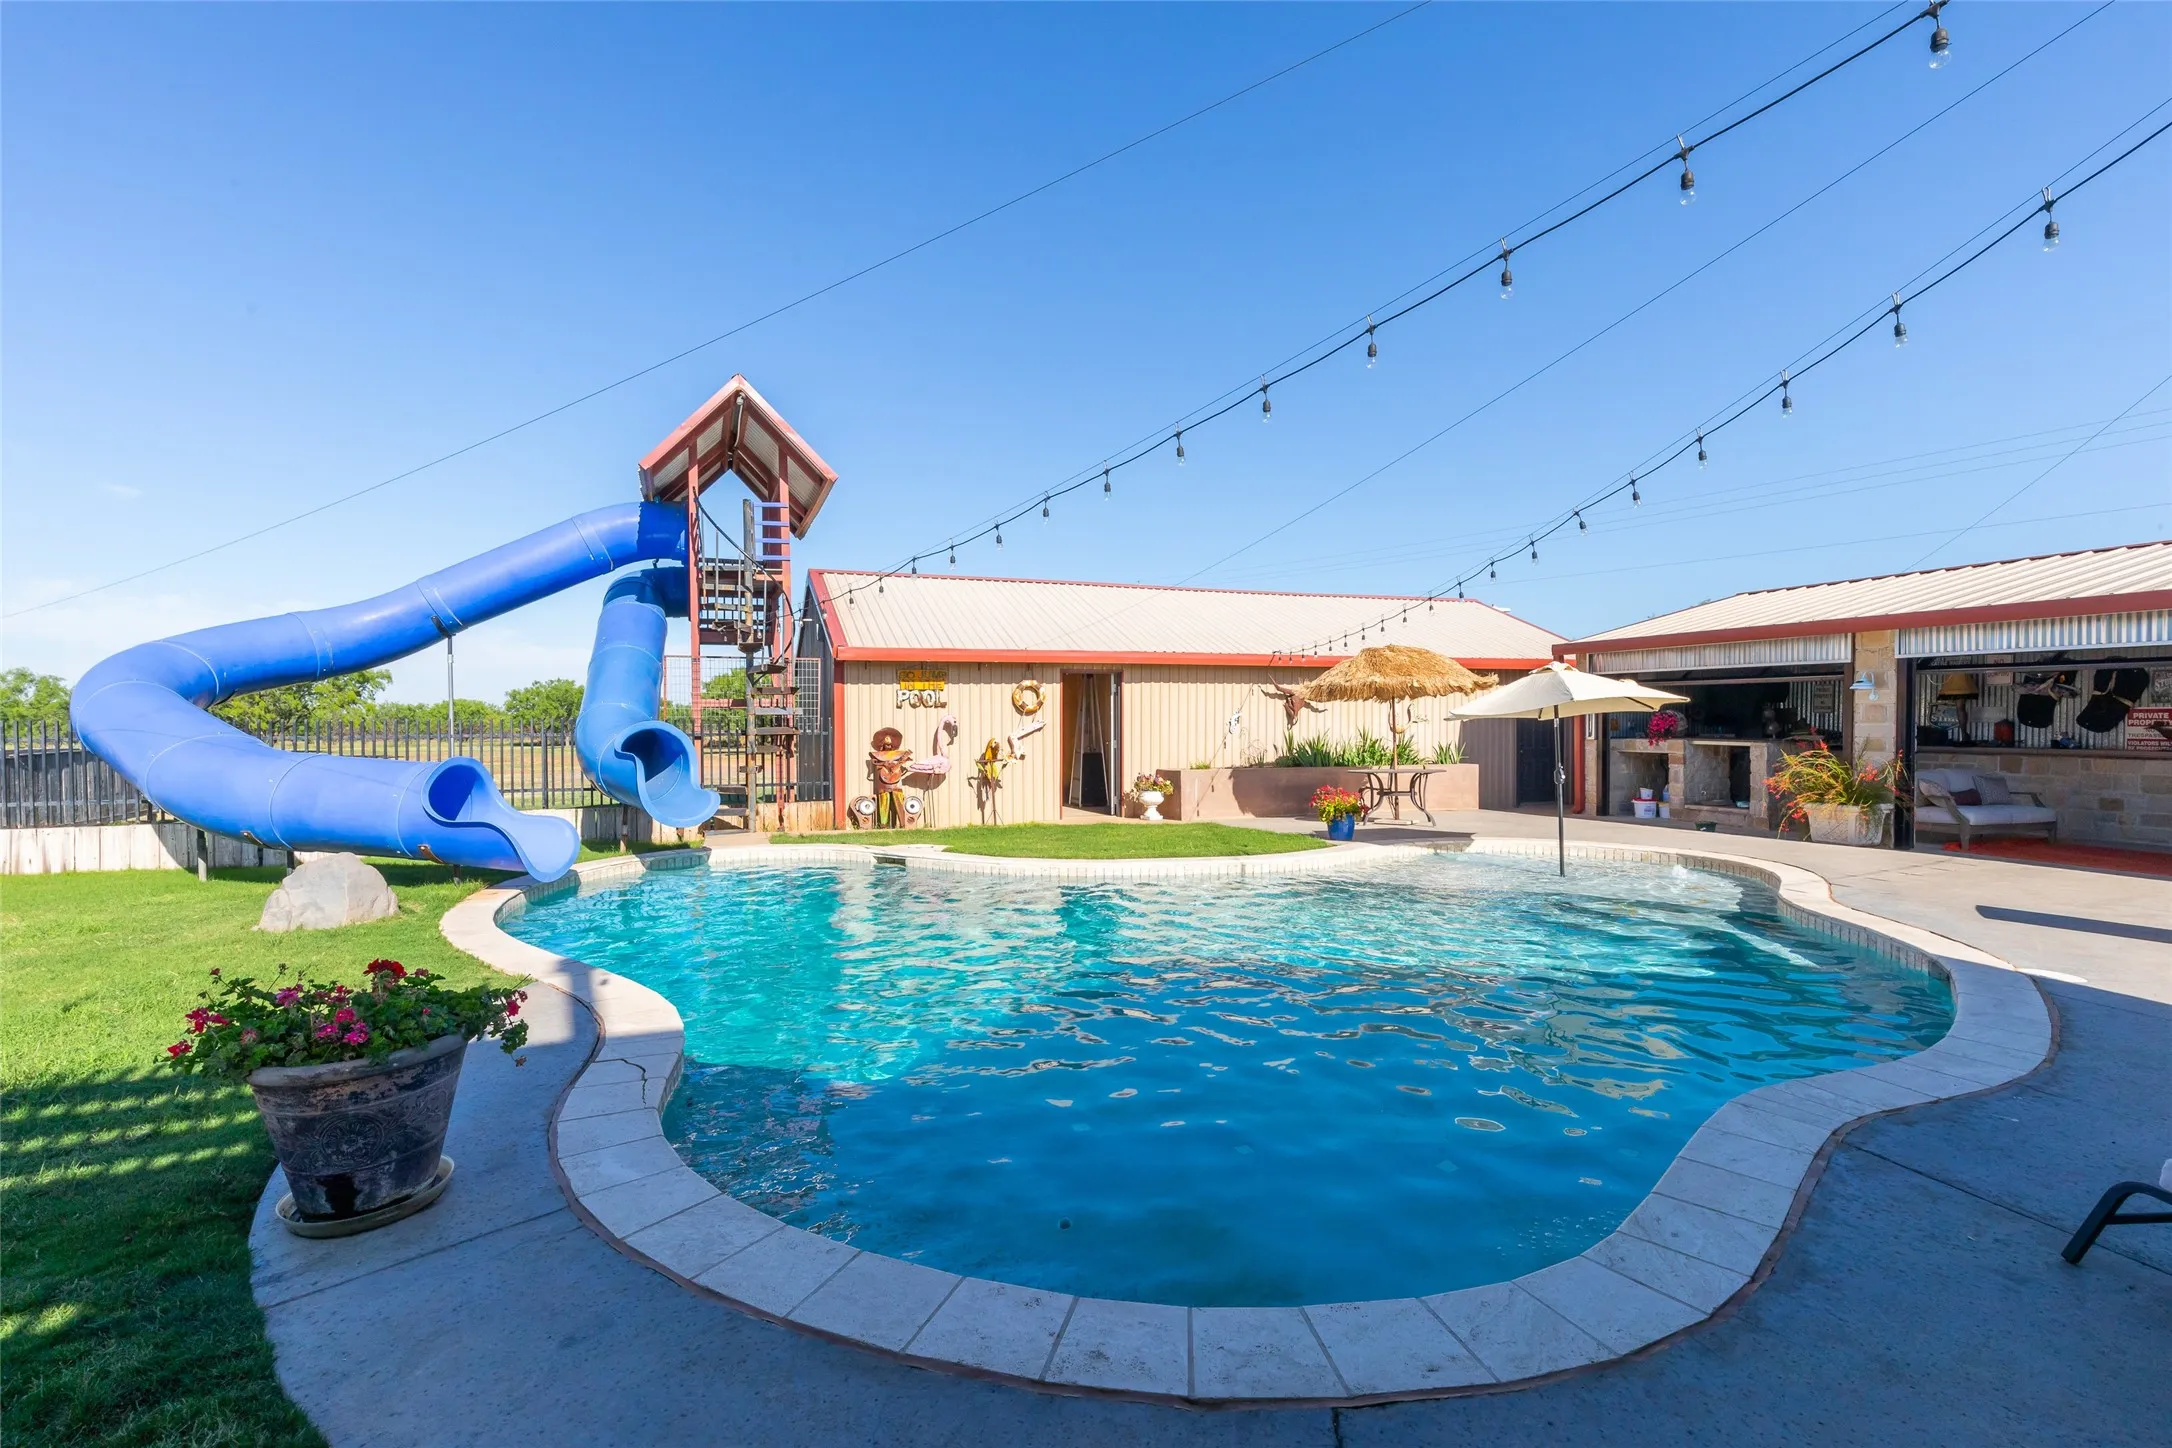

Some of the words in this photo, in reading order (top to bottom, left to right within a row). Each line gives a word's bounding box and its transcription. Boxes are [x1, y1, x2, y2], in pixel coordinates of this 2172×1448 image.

[919, 670, 947, 680] JUMP
[921, 682, 944, 690] THE
[896, 689, 947, 709] POOL
